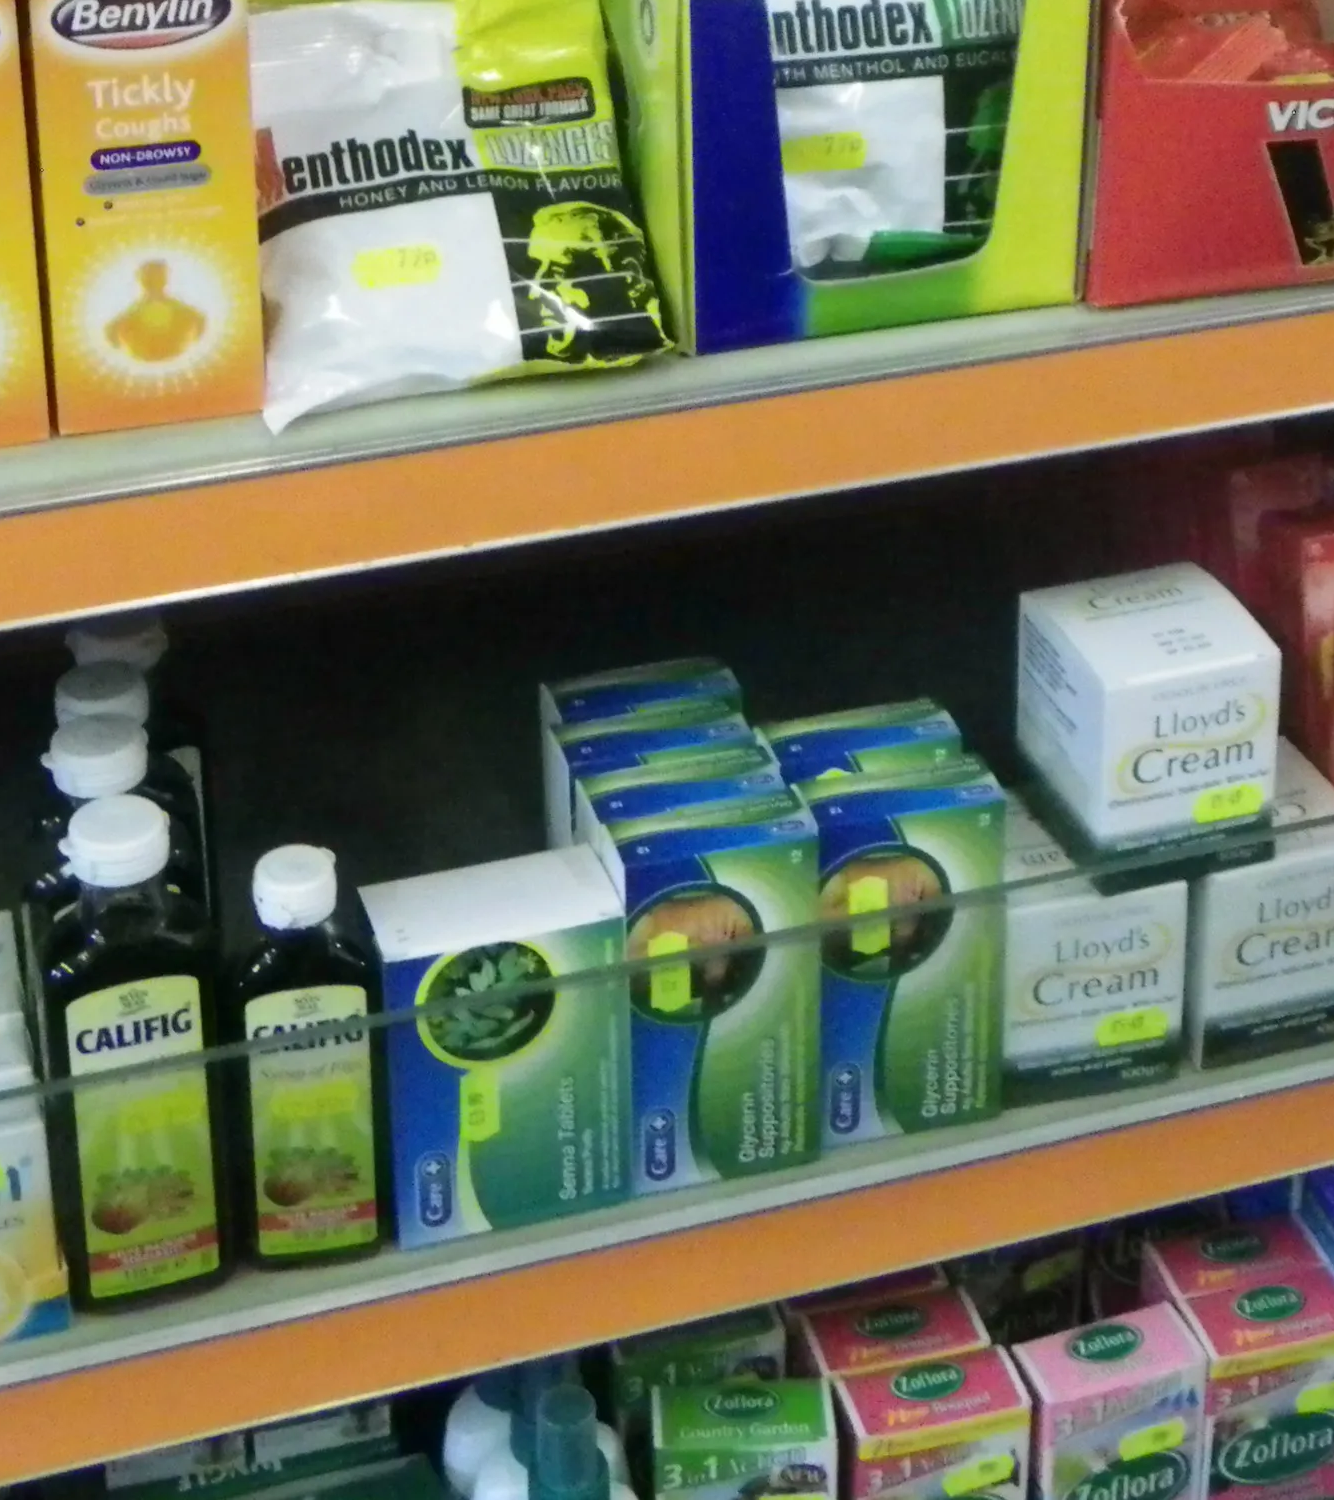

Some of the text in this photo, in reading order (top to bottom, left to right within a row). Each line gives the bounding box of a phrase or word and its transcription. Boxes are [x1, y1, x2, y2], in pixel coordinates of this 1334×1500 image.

[814, 54, 949, 79] MENTHOL AND
[87, 74, 195, 111] Tickly
[95, 112, 191, 140] Coughs
[485, 121, 616, 167] LOZENGES
[99, 146, 191, 165] NON-DROWSY
[339, 171, 622, 208] HONEY AND LEMON FLAVOUR
[1154, 699, 1246, 740] Lloyd's
[1131, 738, 1255, 786] Cream
[1054, 928, 1149, 965] Lloyd's
[1033, 967, 1159, 1009] Cream
[76, 1007, 193, 1055] CALIFIG
[558, 1076, 577, 1201] Senna Tablets
[650, 1135, 669, 1177] Care
[425, 1180, 445, 1224] Care
[1240, 1290, 1300, 1316] Zoflora
[1070, 1327, 1138, 1360] Zoflora
[898, 1366, 960, 1396] Zoflora
[710, 1391, 775, 1413] Zoflora
[679, 1421, 813, 1442] Country Garden
